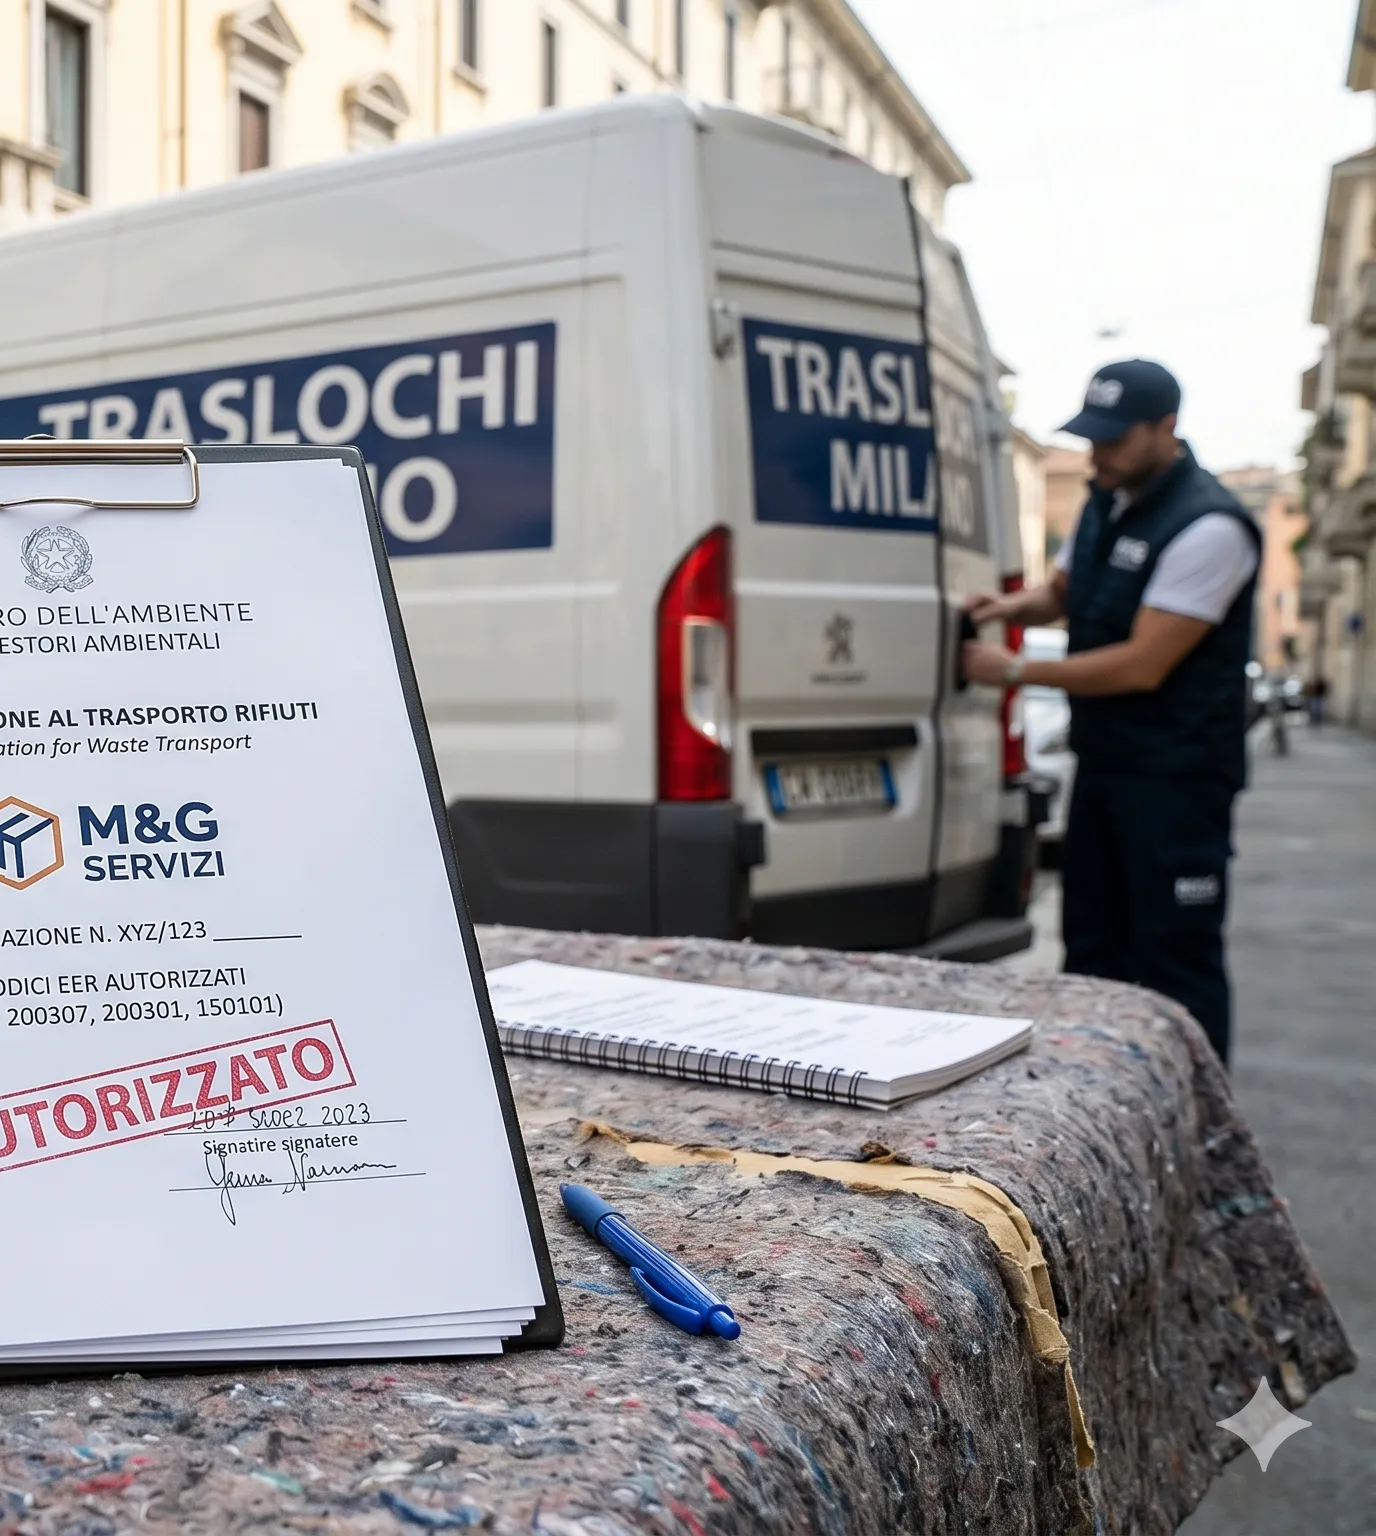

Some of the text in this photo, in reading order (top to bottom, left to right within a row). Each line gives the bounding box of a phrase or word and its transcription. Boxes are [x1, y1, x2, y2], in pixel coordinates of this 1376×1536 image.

[37, 601, 254, 627] DELL'AMBIENTE
[83, 631, 221, 654] AMBIENTALI
[47, 708, 79, 728] AL
[83, 704, 229, 728] TRASPORTO
[234, 701, 319, 723] RIFIUTI
[51, 738, 83, 759] for
[88, 737, 150, 755] Waste
[155, 733, 253, 755] Transport
[77, 801, 219, 846] M&G
[83, 850, 225, 882] SERVIZI
[89, 924, 112, 944] N.
[117, 919, 208, 946] XYZ/123
[58, 973, 99, 994] EER
[104, 966, 247, 992] AUTORIZZATI
[7, 1003, 96, 1027] 200307,
[101, 999, 191, 1023] 200301,
[196, 993, 285, 1019] 150101)
[321, 1102, 371, 1126] 2023
[202, 1133, 359, 1158] Signatire signatere
